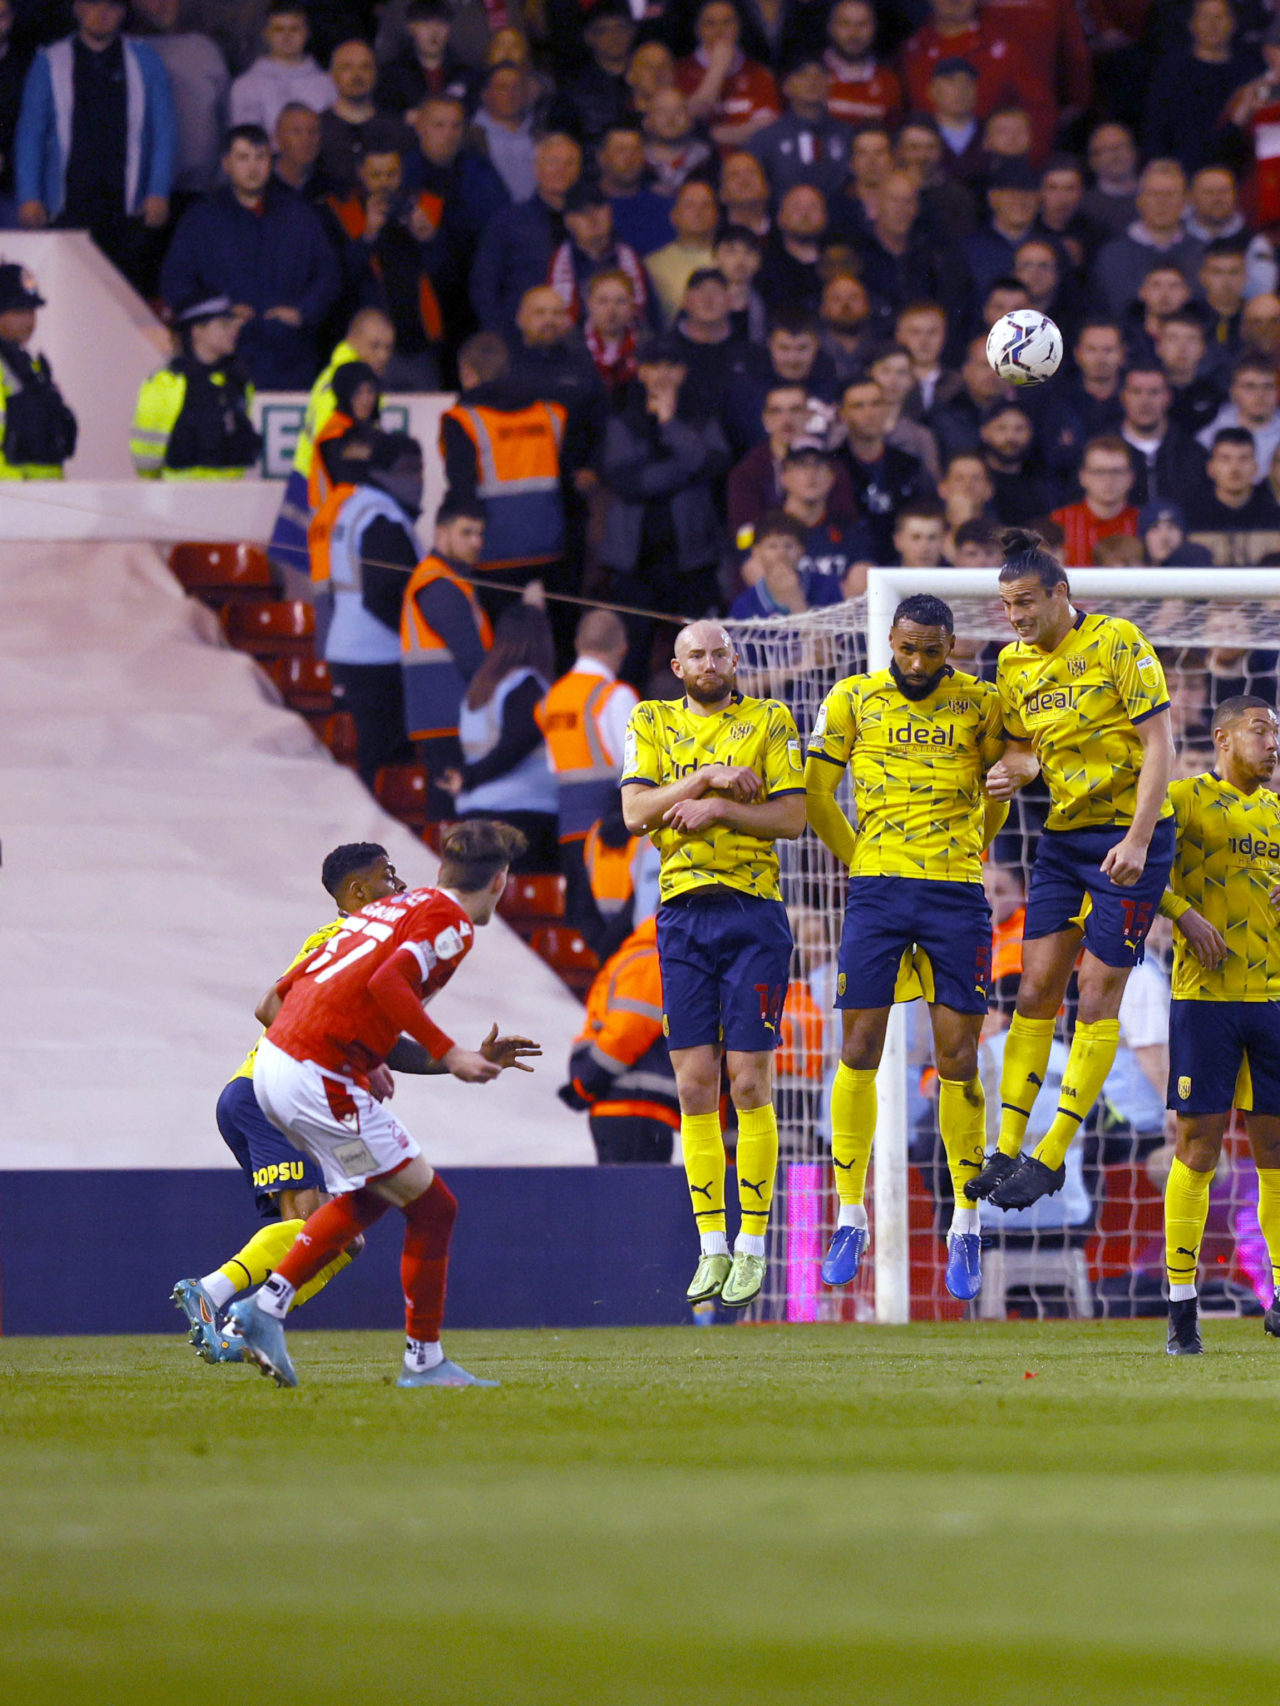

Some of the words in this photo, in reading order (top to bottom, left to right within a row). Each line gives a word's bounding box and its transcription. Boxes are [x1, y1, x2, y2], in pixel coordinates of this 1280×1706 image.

[888, 722, 954, 747] ideal
[674, 755, 732, 780] idl
[304, 916, 394, 984] 37
